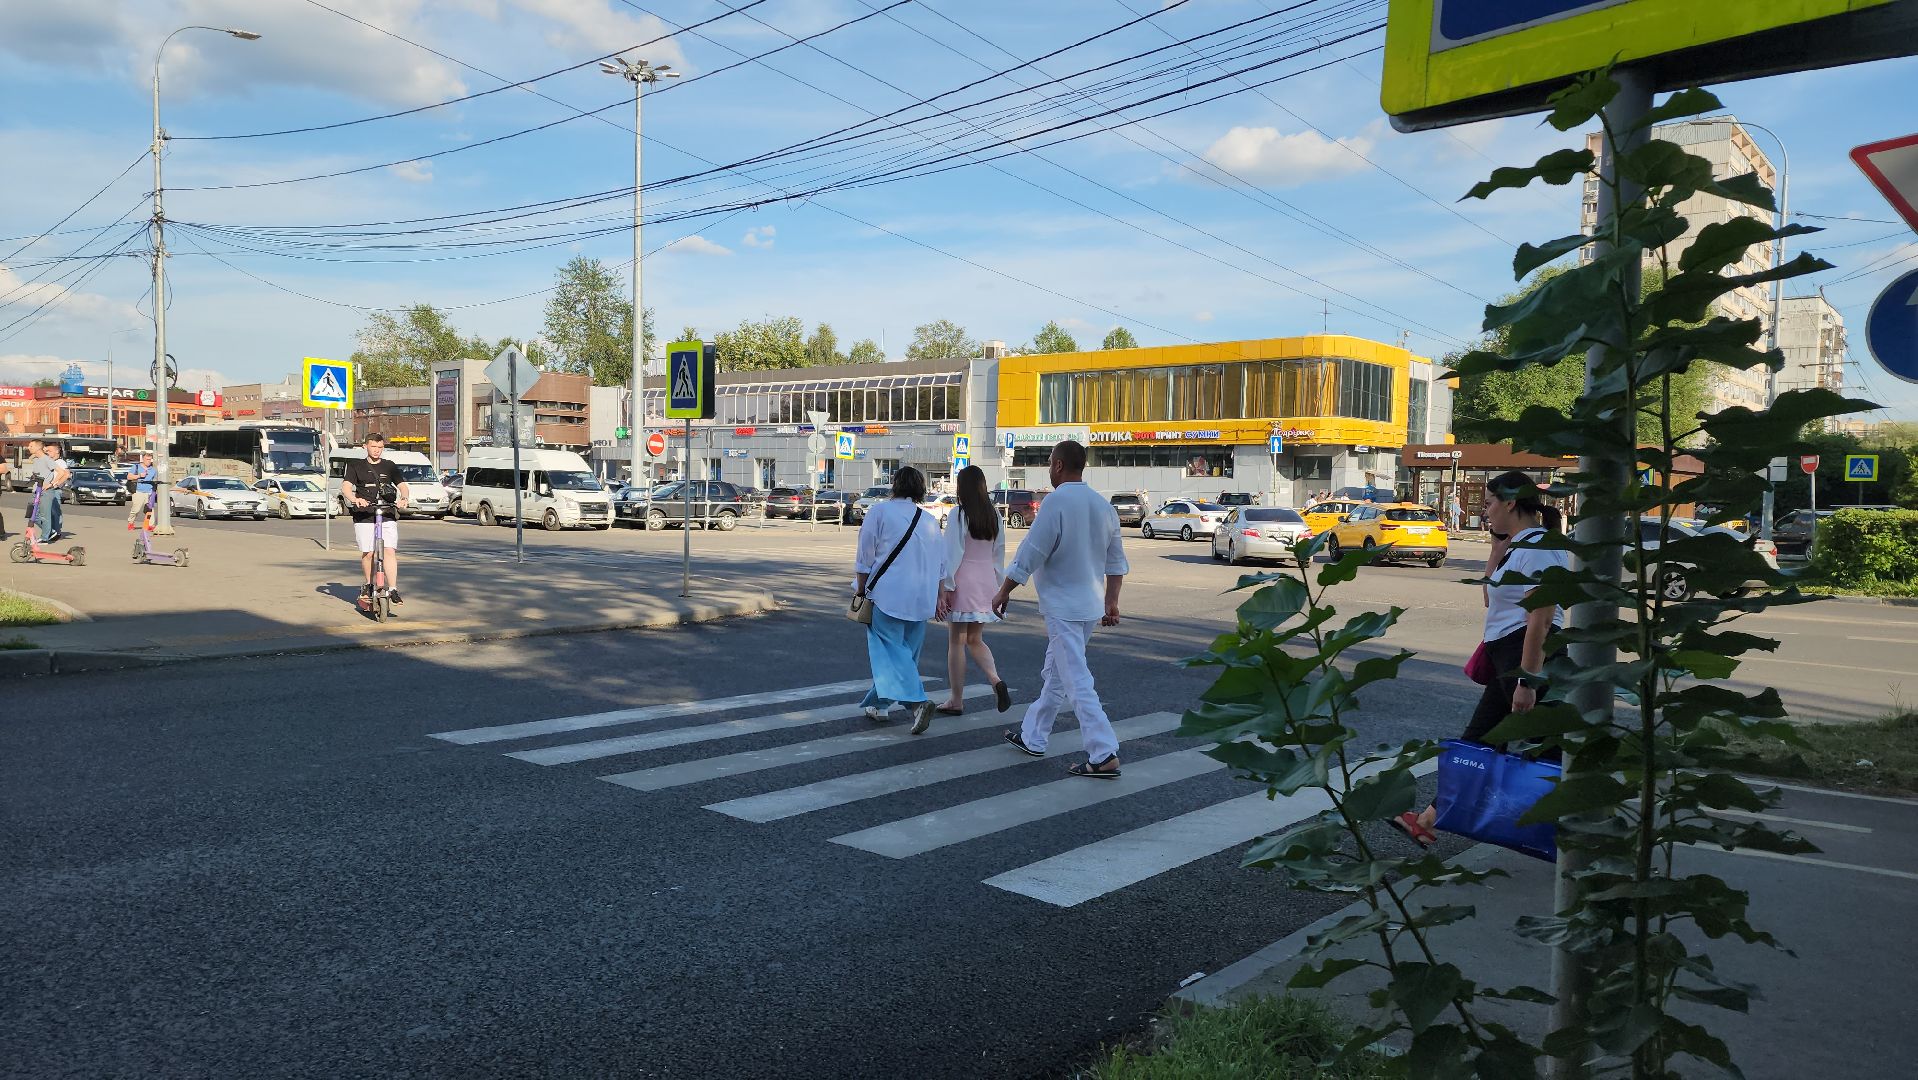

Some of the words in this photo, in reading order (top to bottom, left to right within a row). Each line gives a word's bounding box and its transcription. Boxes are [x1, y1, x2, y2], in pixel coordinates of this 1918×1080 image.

[1089, 431, 1133, 442] ОПТИКА
[1184, 429, 1220, 439] СУМКИ
[1452, 756, 1485, 769] SIGMA
